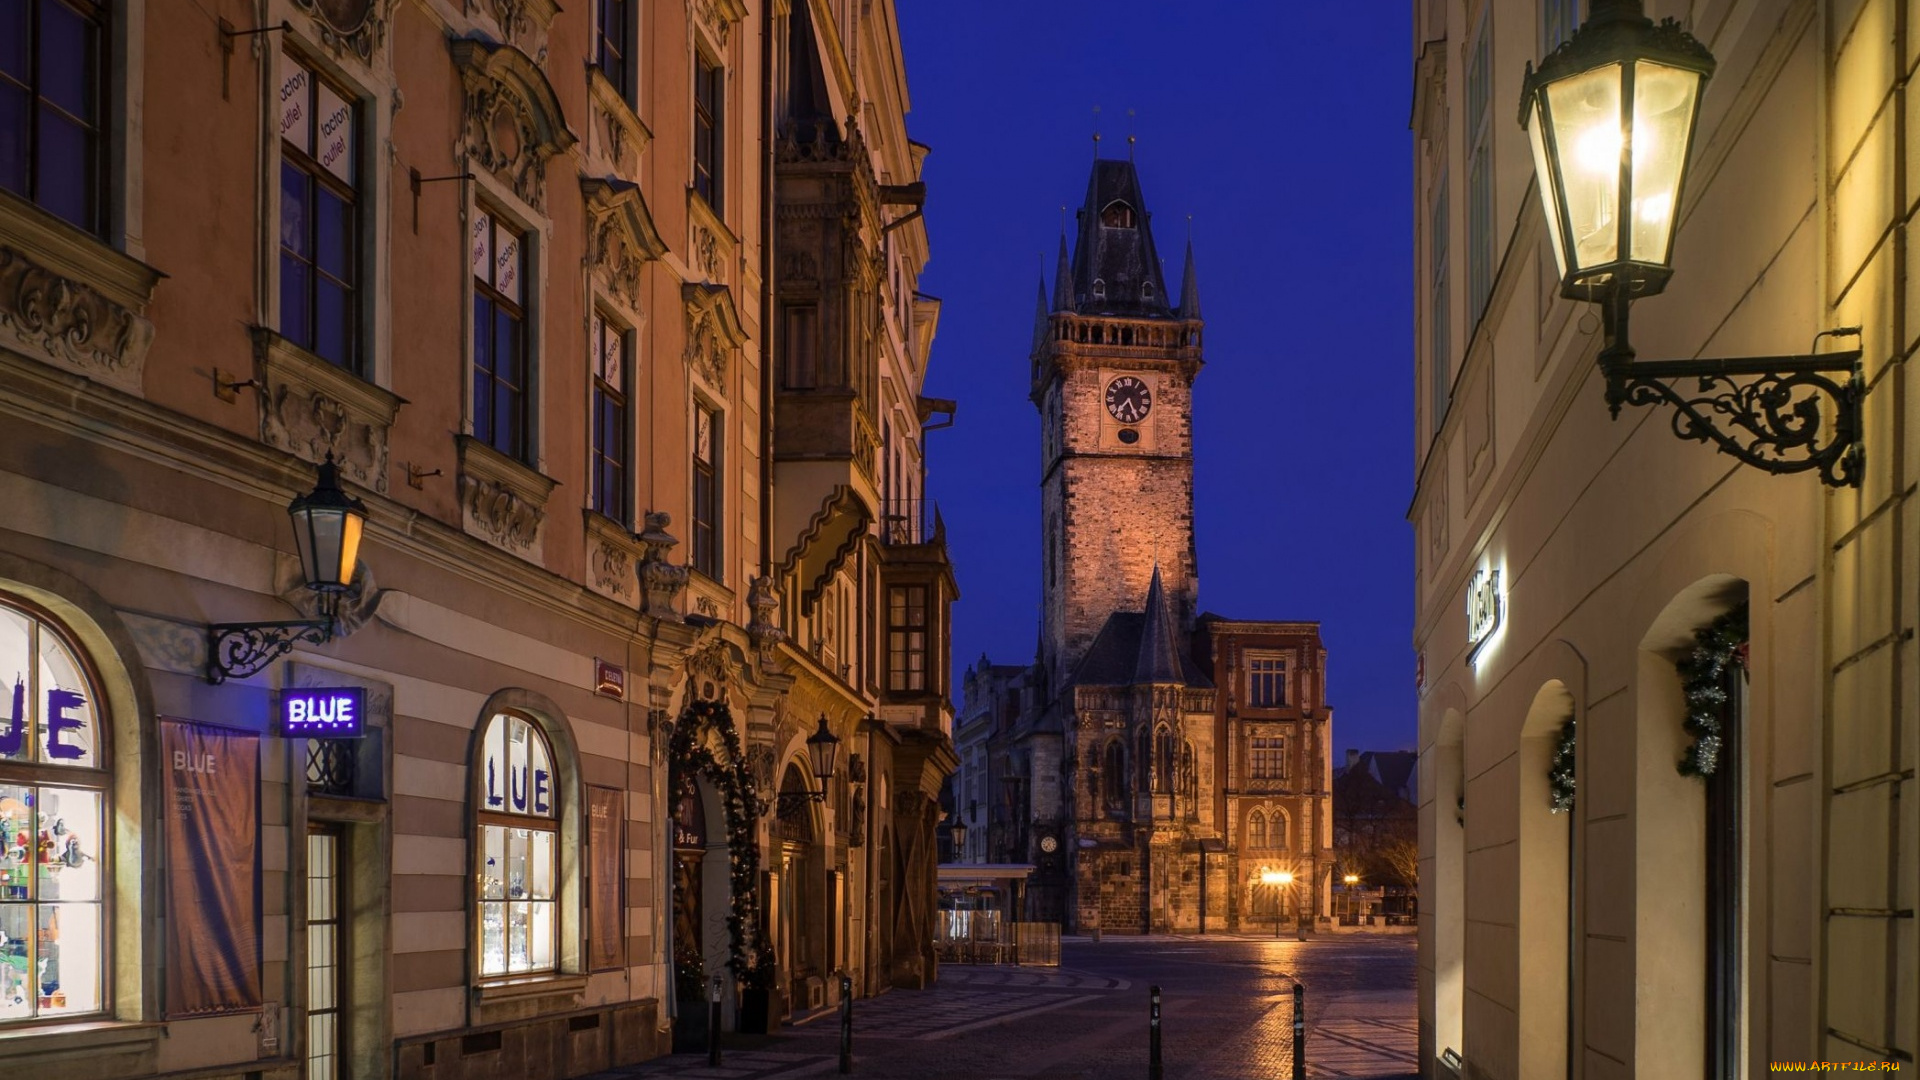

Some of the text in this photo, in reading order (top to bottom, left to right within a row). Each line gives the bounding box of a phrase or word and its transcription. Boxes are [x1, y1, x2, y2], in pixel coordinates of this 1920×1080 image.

[321, 105, 350, 138] factory
[323, 136, 346, 167] outlet
[289, 696, 353, 723] BLUE
[174, 751, 216, 773] BLUE
[591, 804, 607, 818] BLUE
[686, 833, 698, 844] Fur
